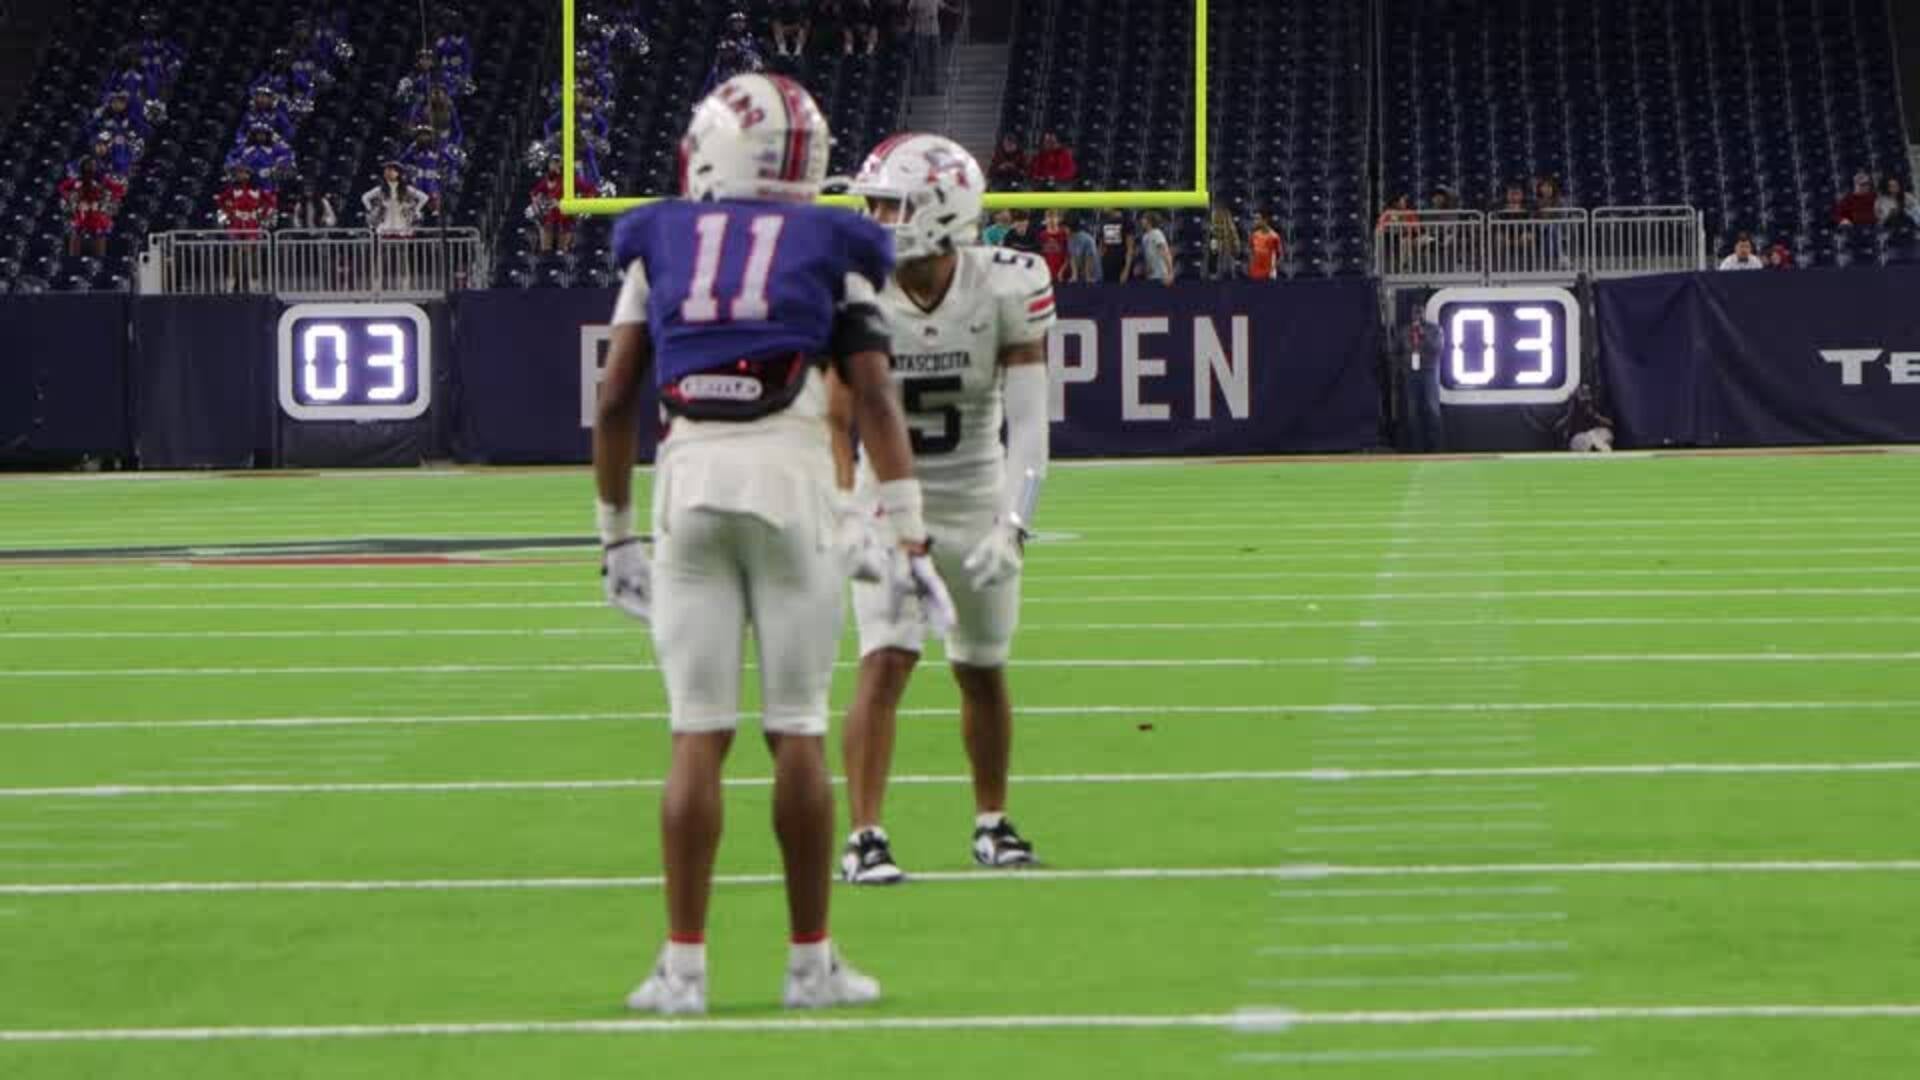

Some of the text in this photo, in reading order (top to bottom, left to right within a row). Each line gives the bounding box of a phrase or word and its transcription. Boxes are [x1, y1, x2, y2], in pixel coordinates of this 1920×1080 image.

[680, 213, 785, 323] 11
[303, 323, 405, 401] 03
[1047, 315, 1248, 421] PEN
[1452, 307, 1553, 385] 03
[903, 375, 962, 456] 5
